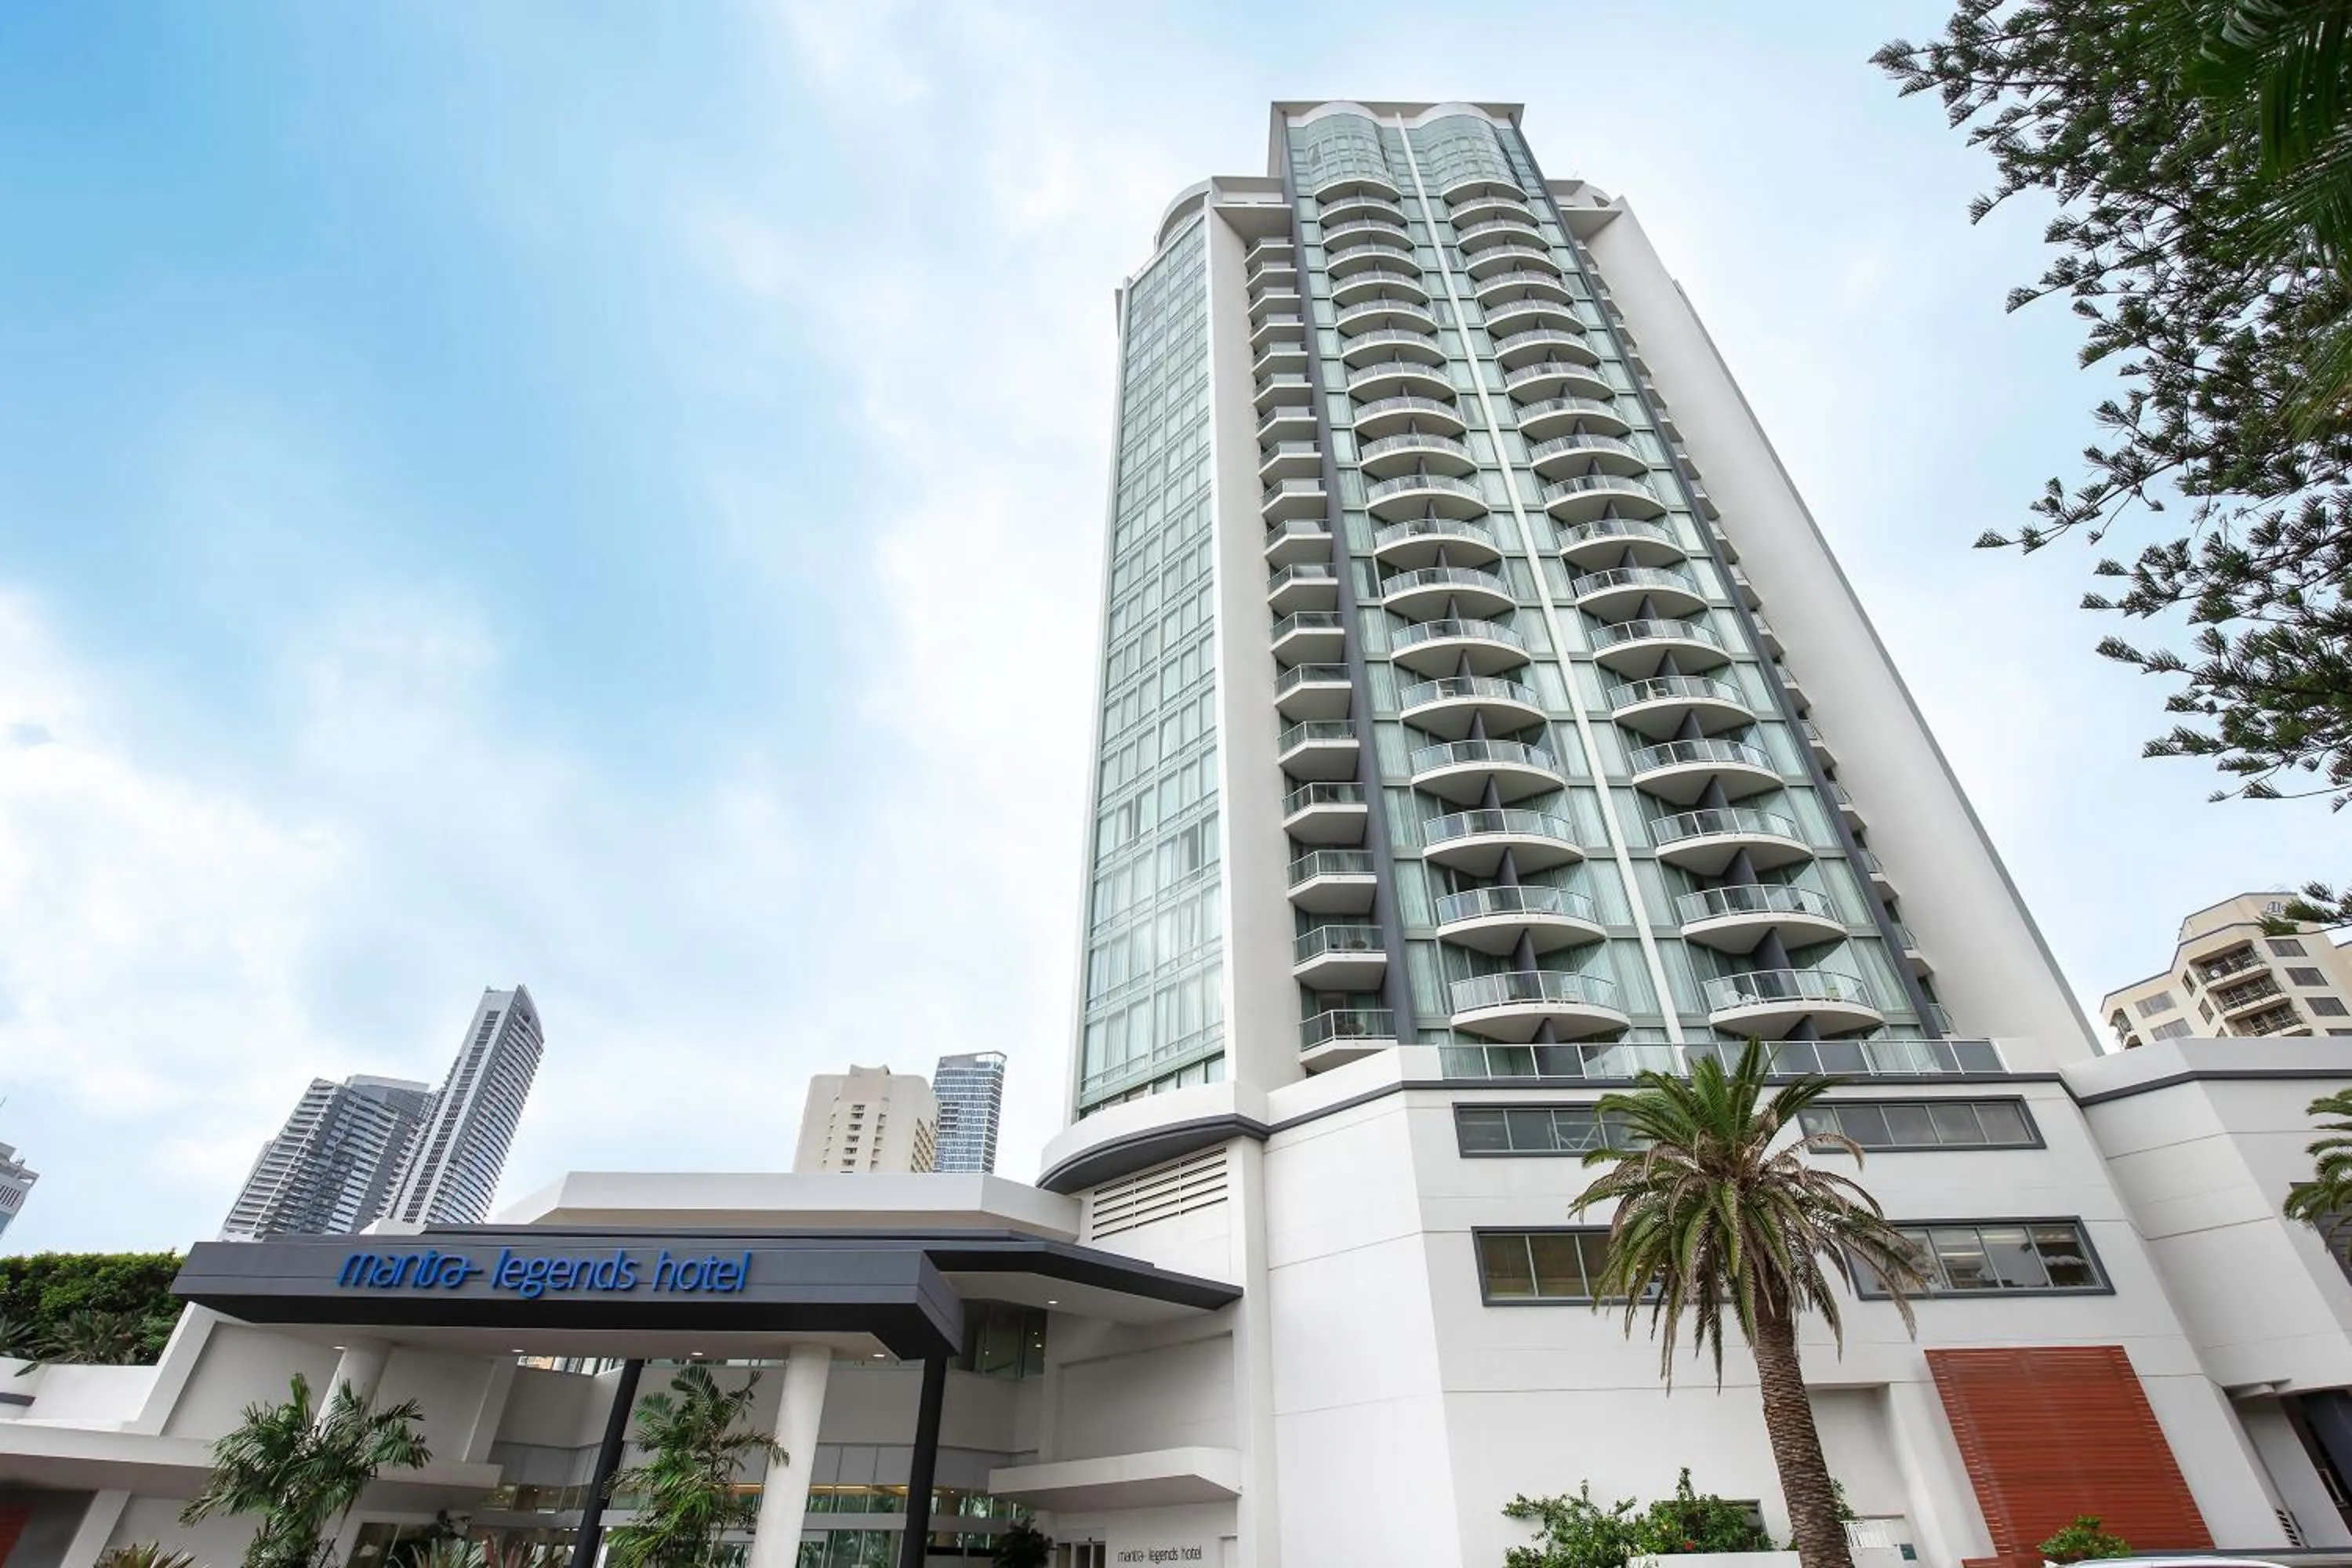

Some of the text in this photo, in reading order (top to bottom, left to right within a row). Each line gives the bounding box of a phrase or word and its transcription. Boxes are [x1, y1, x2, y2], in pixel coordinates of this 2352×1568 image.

[339, 1247, 753, 1298] mantra legends hotel
[1149, 1547, 1178, 1564] legends
